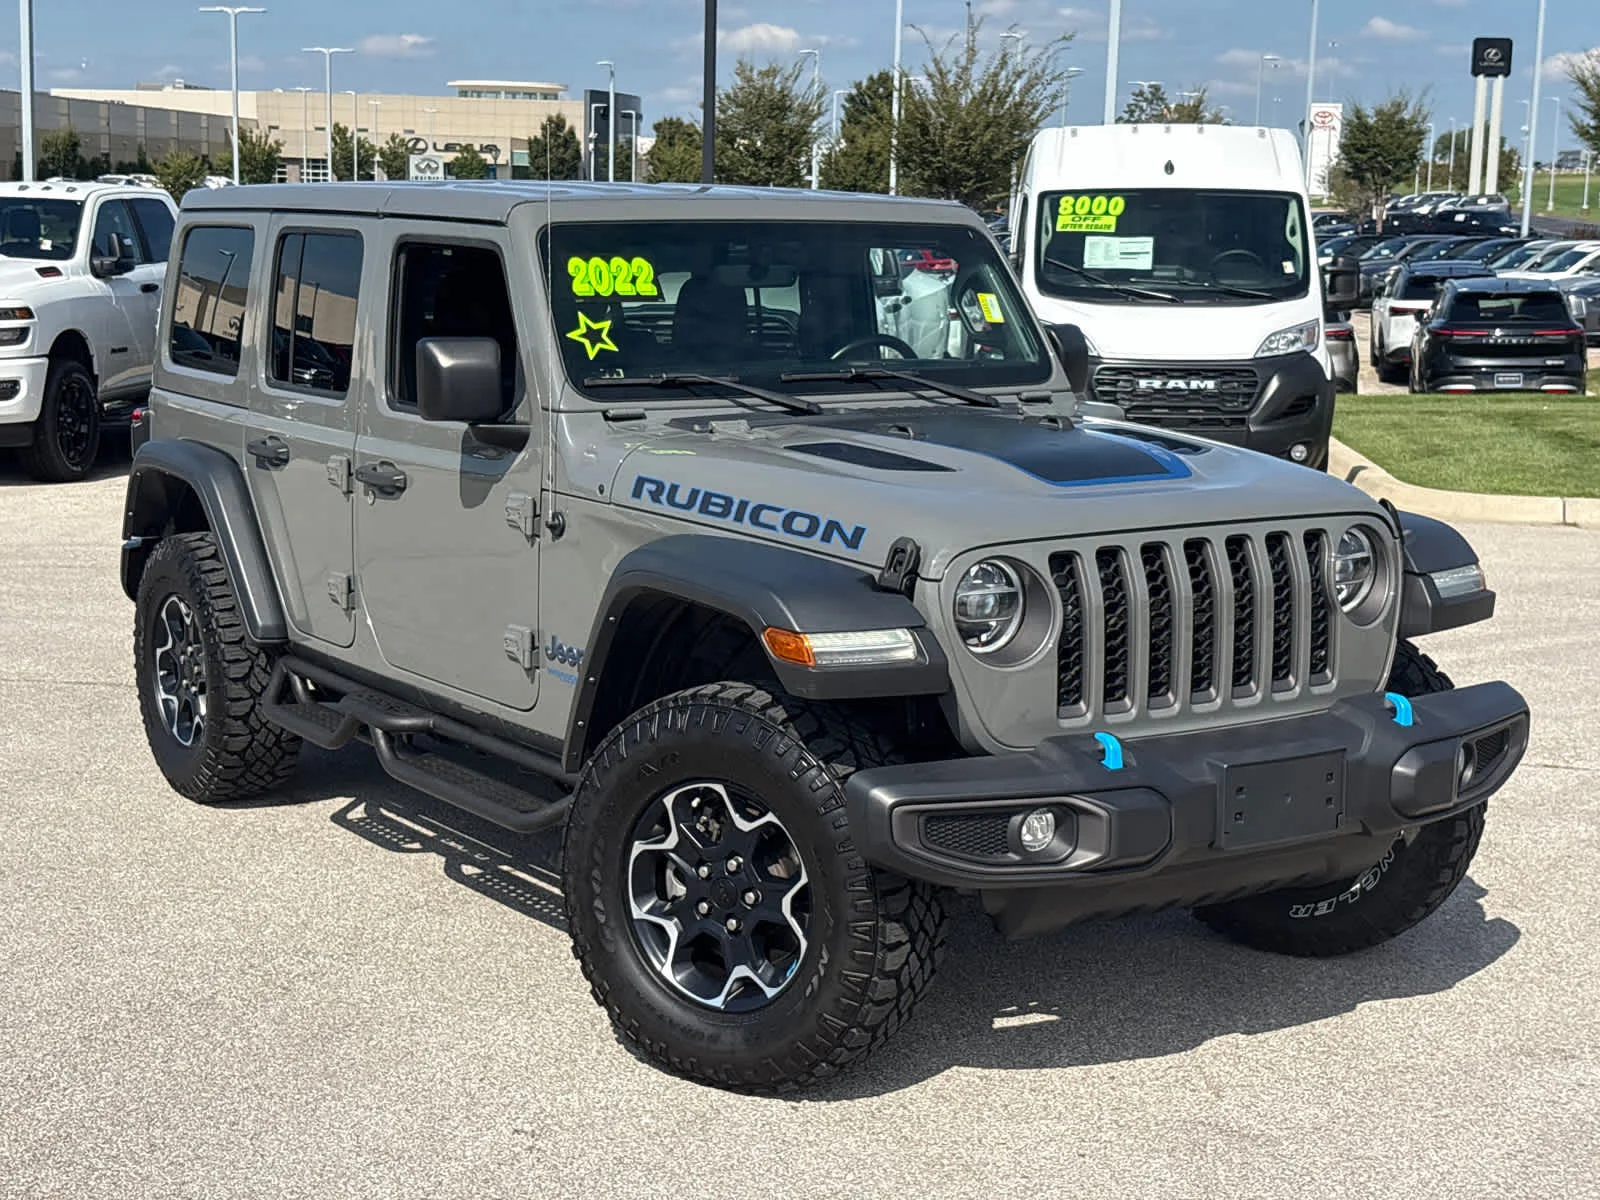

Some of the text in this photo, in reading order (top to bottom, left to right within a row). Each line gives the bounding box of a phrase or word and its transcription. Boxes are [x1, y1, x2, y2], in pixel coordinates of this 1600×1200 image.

[1058, 195, 1126, 217] 8000
[567, 256, 658, 297] 2022
[1138, 379, 1216, 390] RAM
[630, 474, 867, 551] RUBICON
